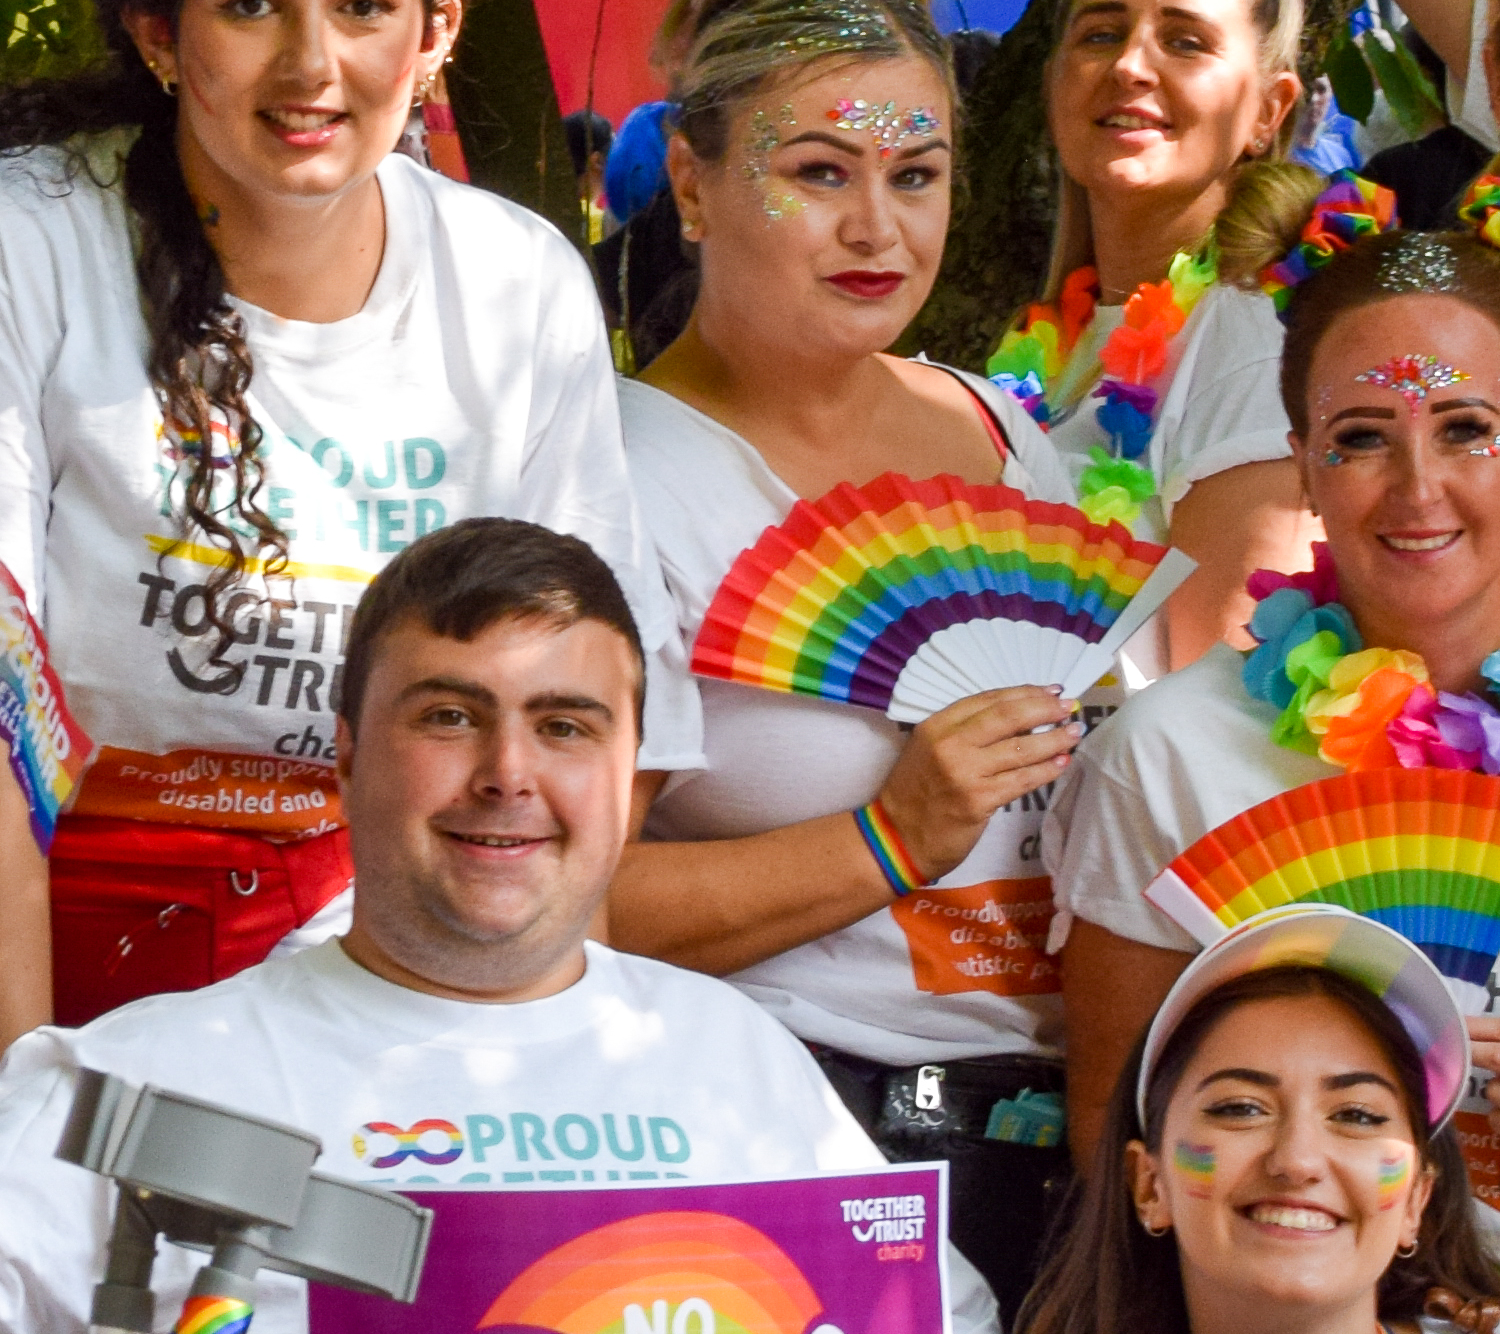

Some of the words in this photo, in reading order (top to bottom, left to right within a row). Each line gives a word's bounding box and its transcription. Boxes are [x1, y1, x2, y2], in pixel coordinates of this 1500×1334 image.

[466, 1112, 691, 1165] PROUD
[841, 1195, 926, 1223] TOGETHER
[874, 1218, 925, 1244] TRUST
[876, 1240, 925, 1262] charity
